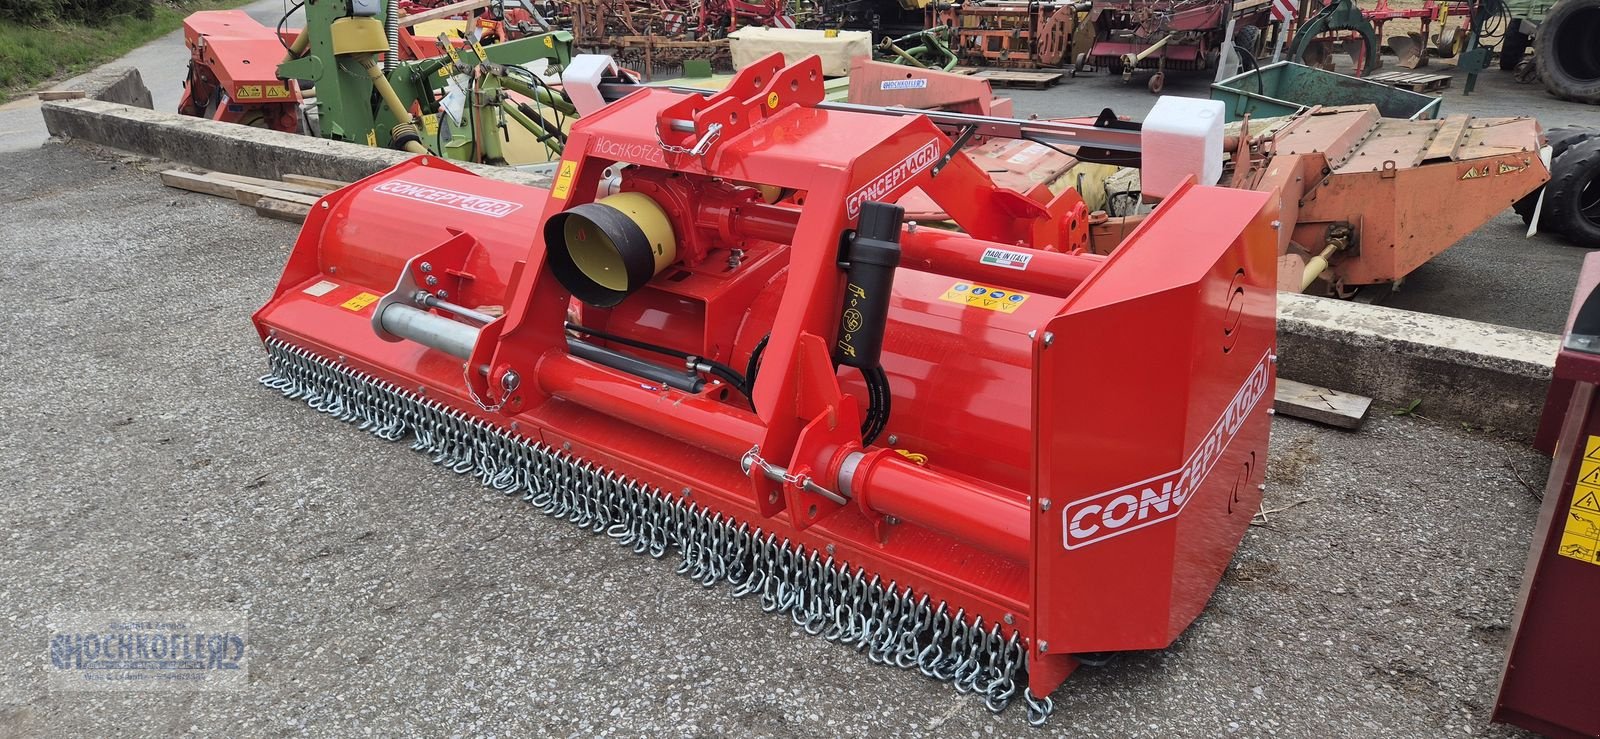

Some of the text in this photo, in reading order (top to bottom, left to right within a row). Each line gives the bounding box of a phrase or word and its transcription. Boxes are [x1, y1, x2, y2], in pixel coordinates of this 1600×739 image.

[380, 182, 511, 217] CONCEPT AGRI
[849, 142, 938, 214] CONCEPT AGRI
[986, 250, 1002, 259] MADE
[1010, 253, 1029, 262] ITALY
[1070, 363, 1267, 539] CONCEPT AGRI
